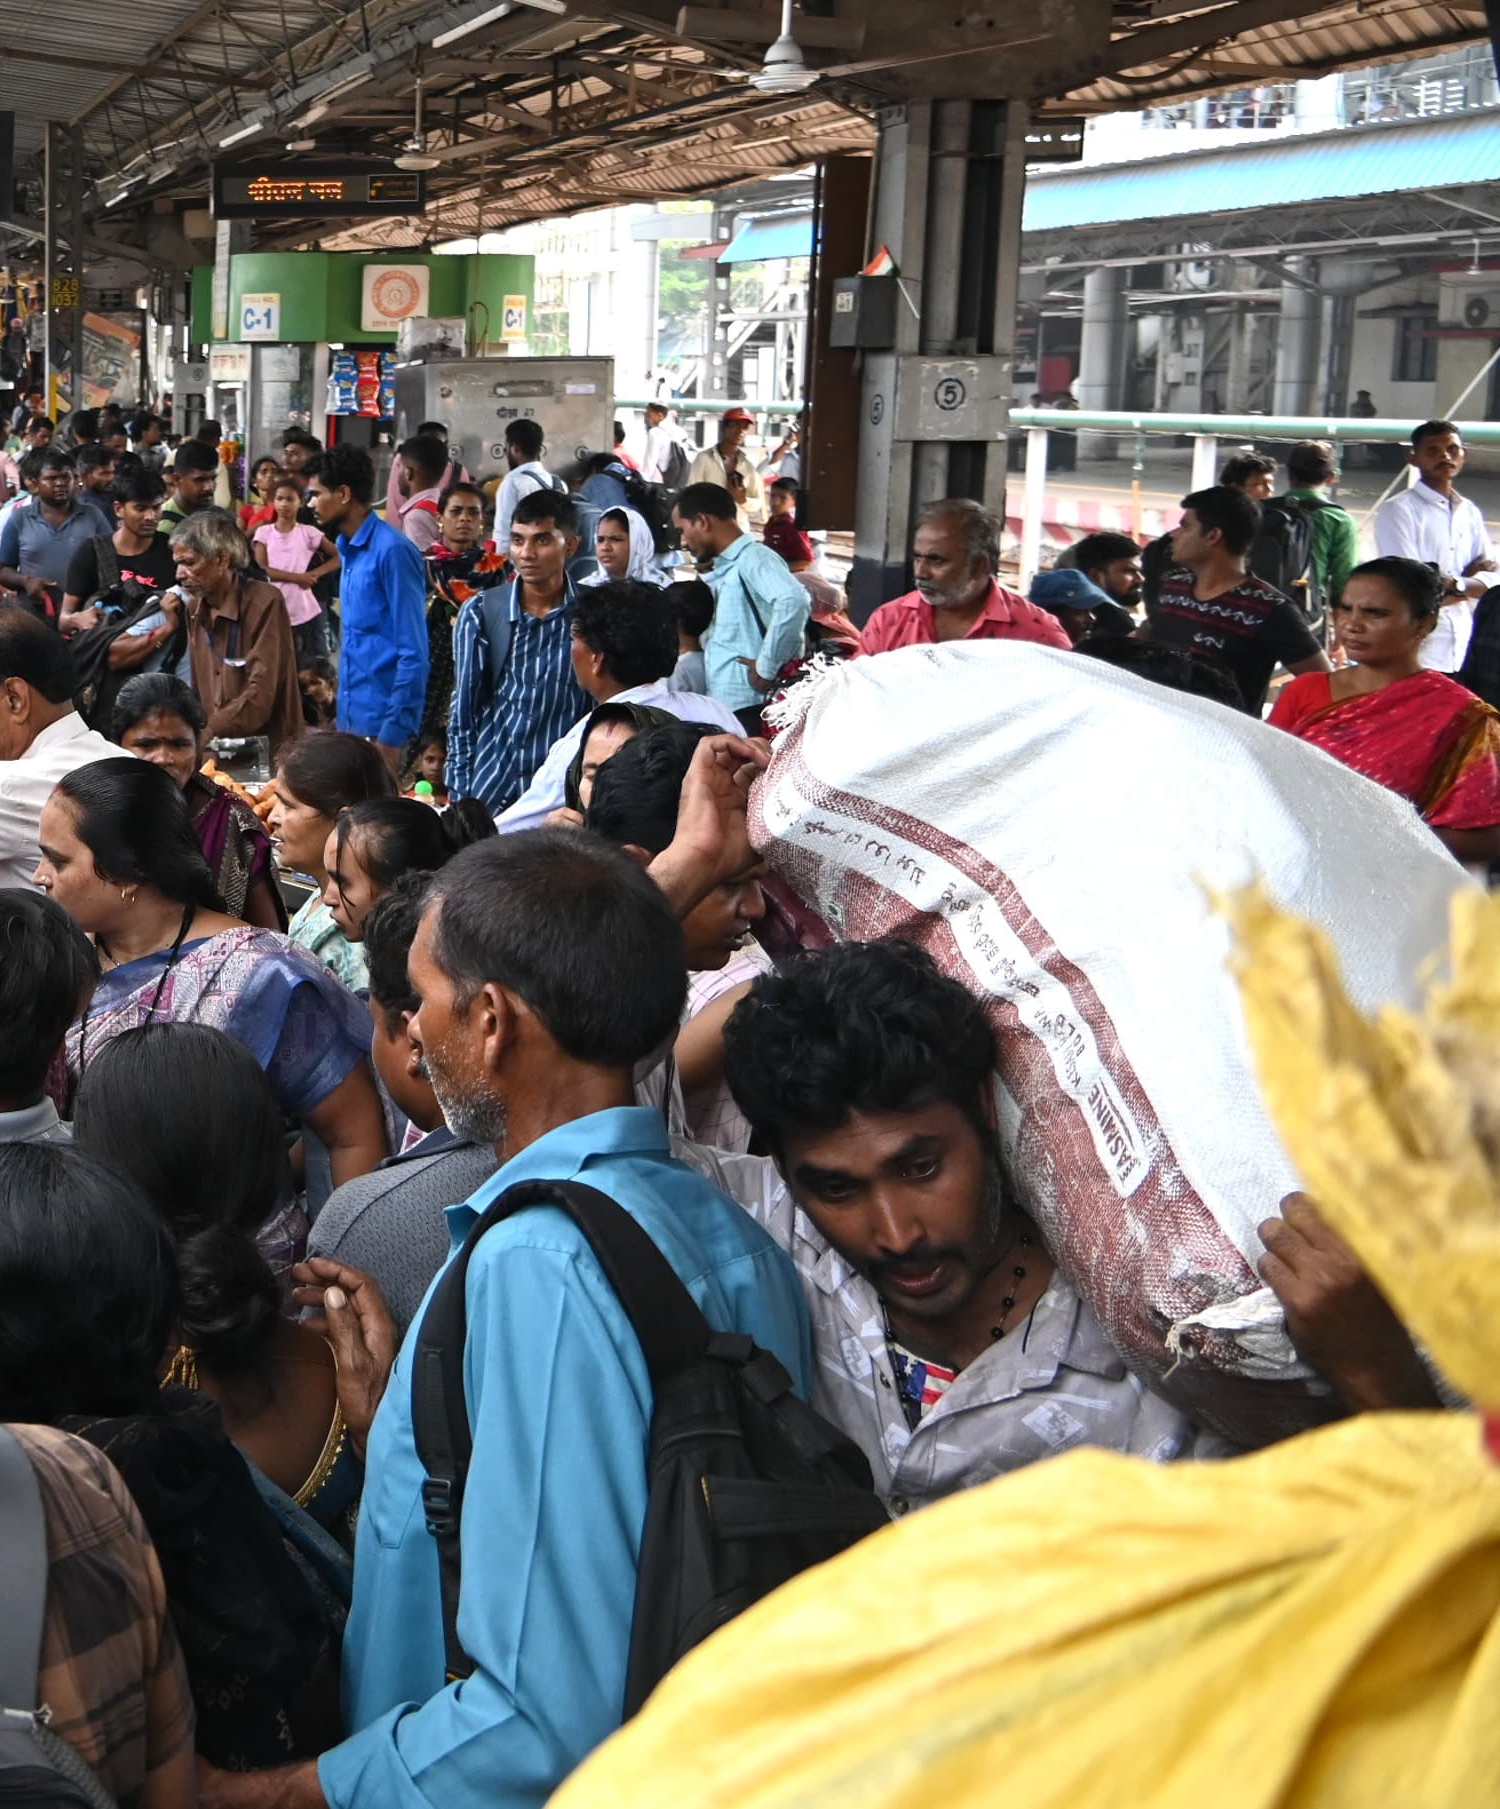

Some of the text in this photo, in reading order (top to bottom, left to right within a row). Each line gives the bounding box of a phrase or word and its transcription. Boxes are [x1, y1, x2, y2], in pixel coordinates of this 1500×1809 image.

[52, 279, 79, 291] 828
[243, 307, 272, 330] C-1
[505, 309, 523, 328] C-1
